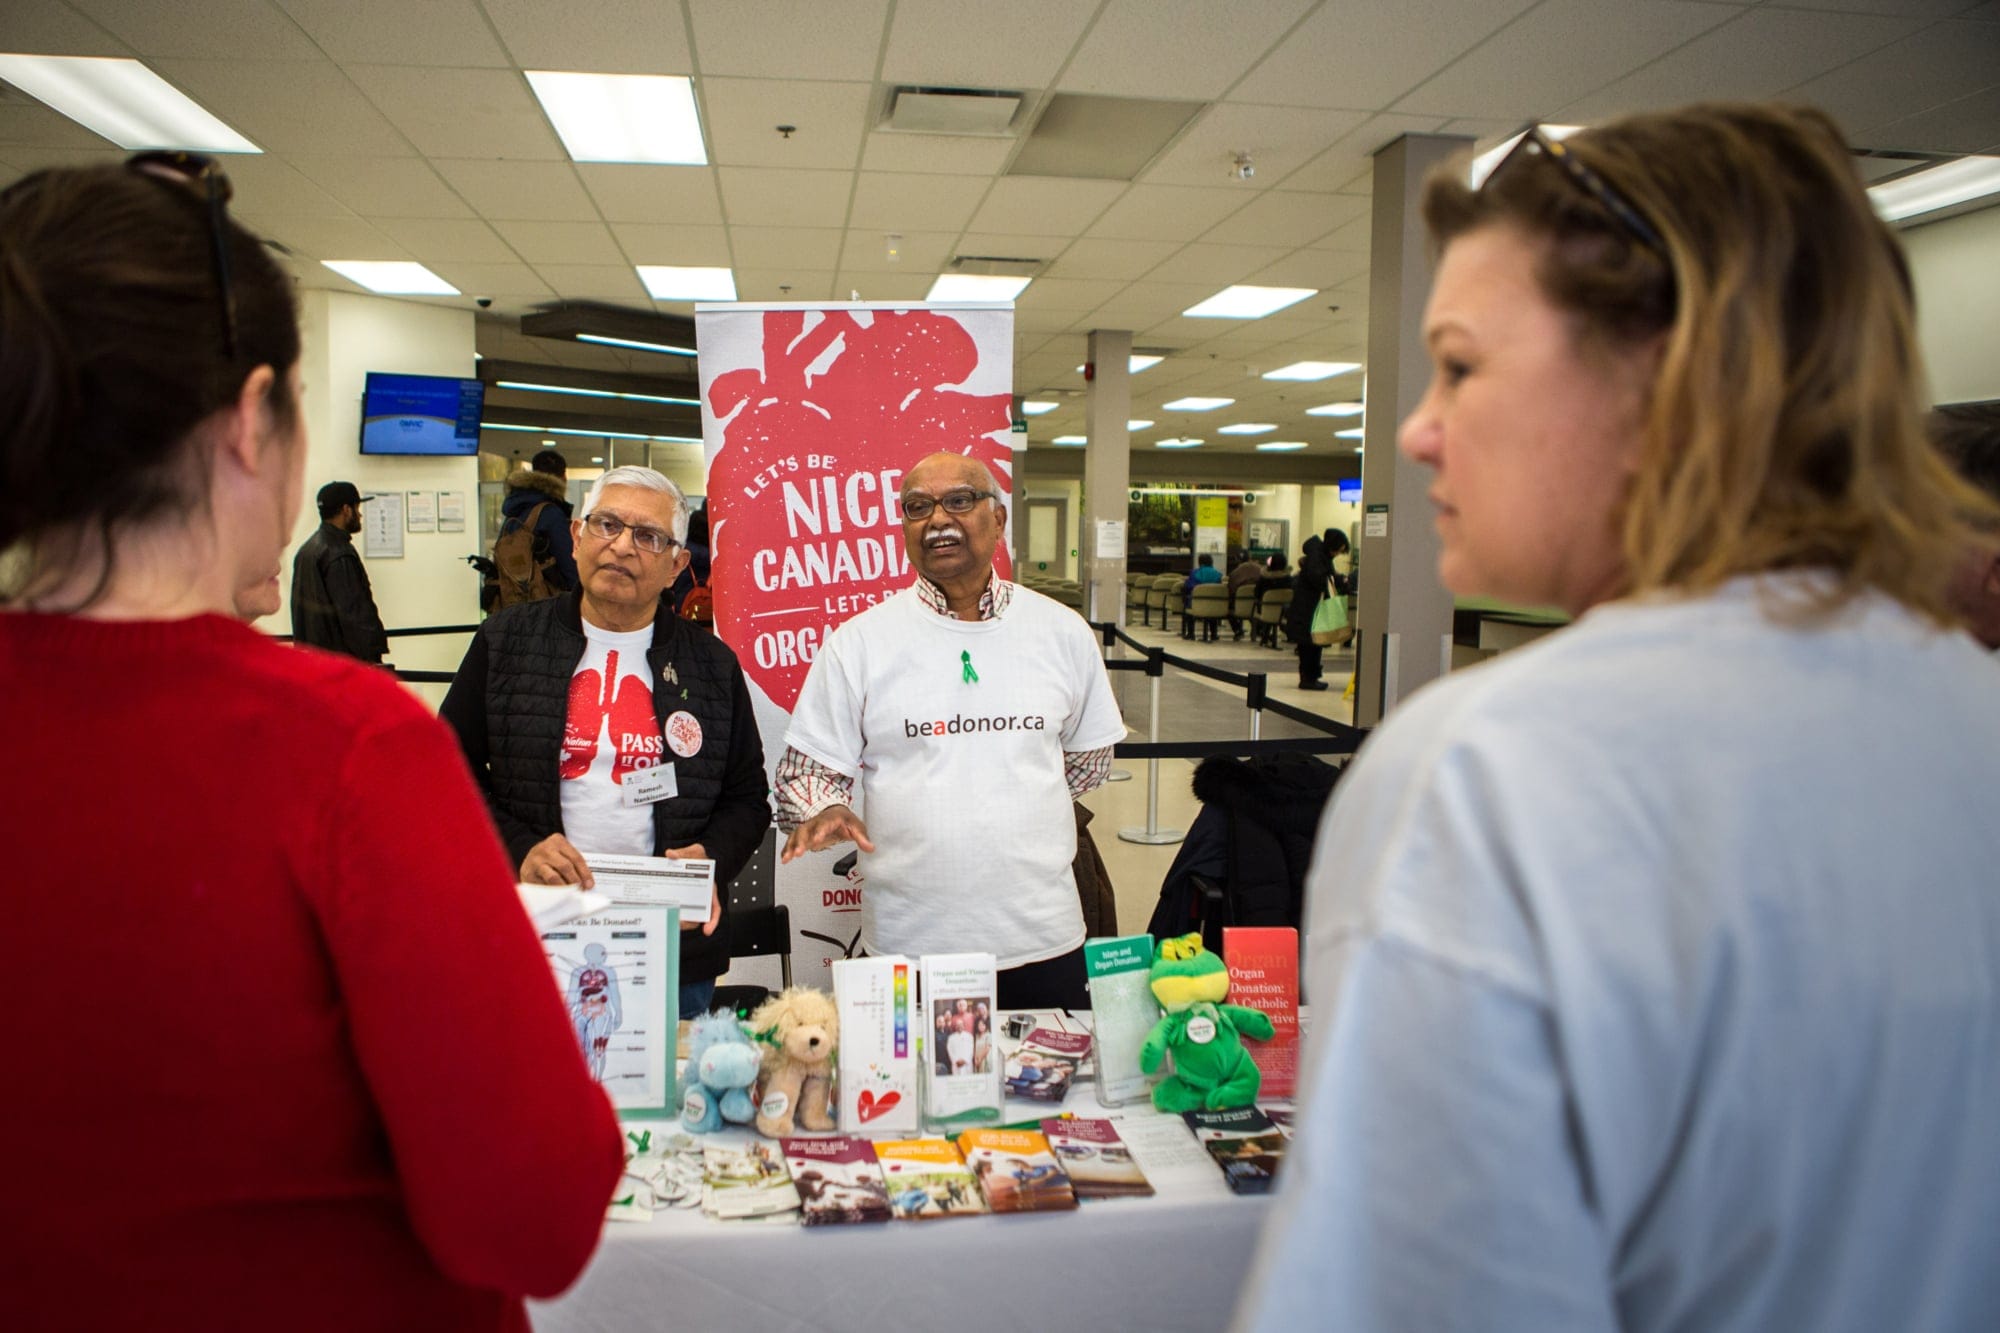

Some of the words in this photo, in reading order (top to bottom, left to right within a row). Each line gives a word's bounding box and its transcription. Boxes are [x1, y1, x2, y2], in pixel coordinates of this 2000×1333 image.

[744, 456, 799, 499] LET'S
[808, 454, 838, 470] BE
[782, 468, 903, 538] NICE
[825, 592, 876, 614] LET'S
[904, 714, 1045, 738] beadonor.ca
[621, 732, 664, 754] PASS
[822, 889, 862, 907] DON
[1230, 967, 1265, 981] Organ
[1231, 983, 1285, 994] Donation:
[1242, 997, 1289, 1009] Catholic
